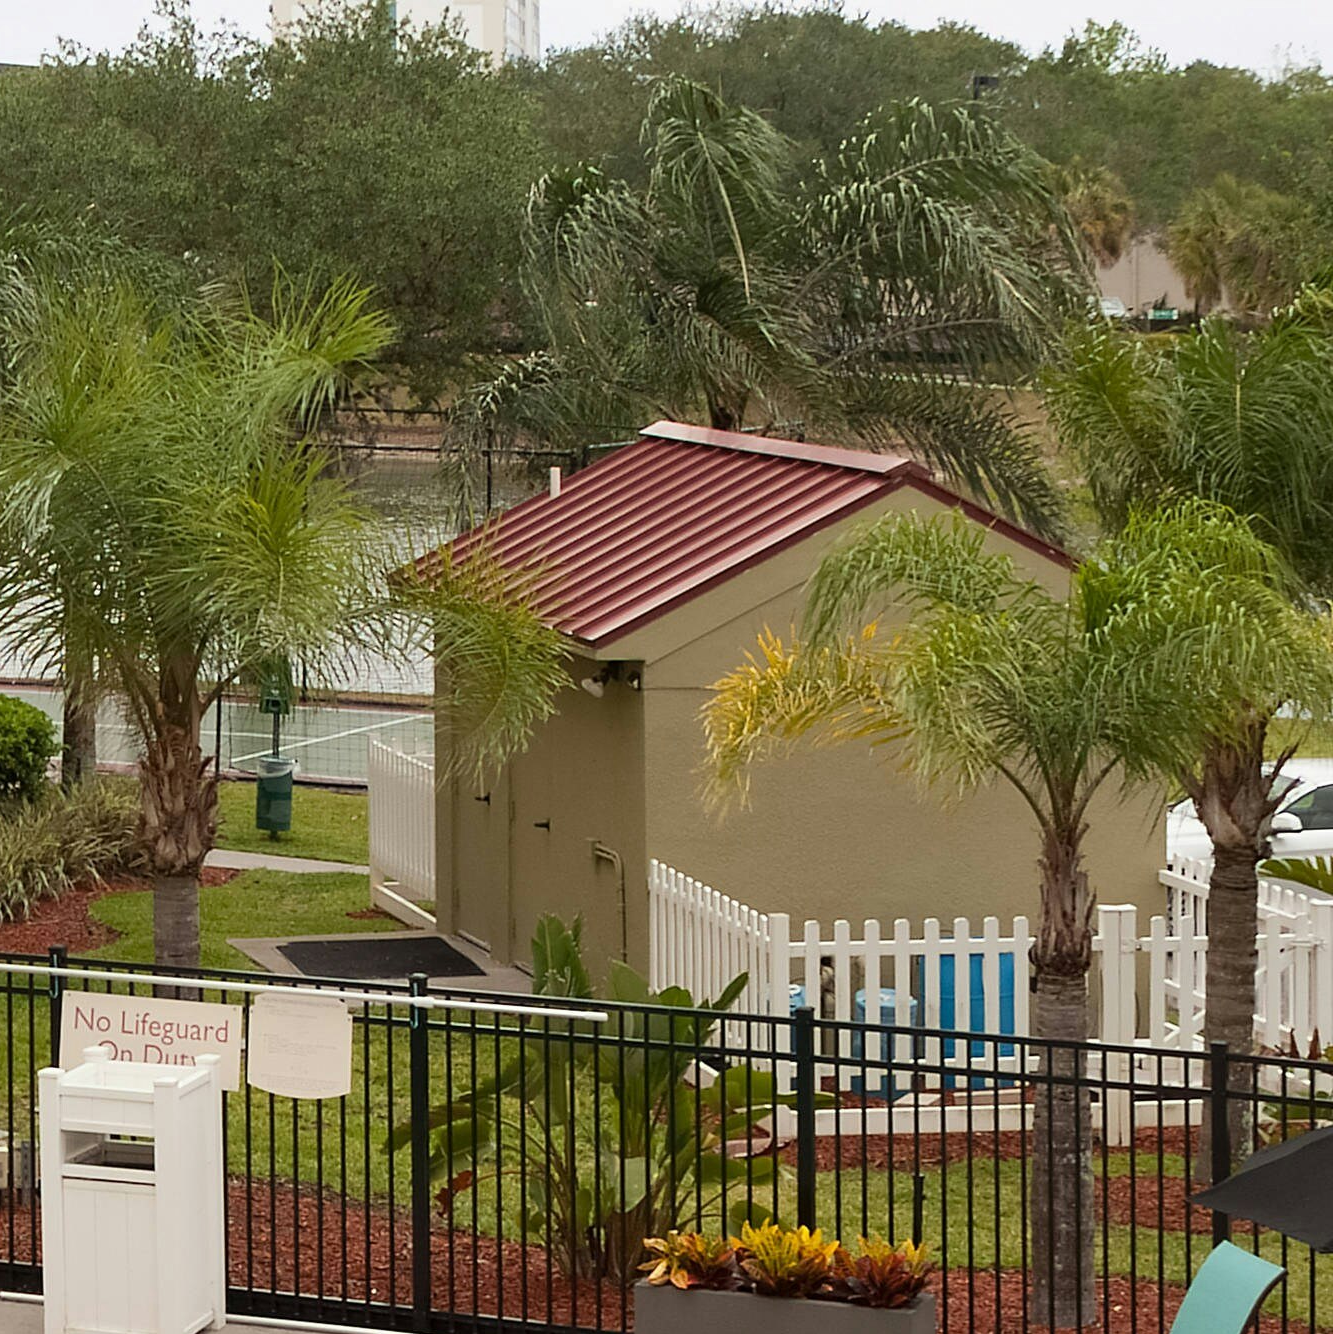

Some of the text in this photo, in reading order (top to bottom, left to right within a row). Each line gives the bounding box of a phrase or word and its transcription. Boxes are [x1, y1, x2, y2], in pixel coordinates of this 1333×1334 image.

[74, 1006, 229, 1045] No Lifeguard
[143, 1044, 196, 1067] Dut
